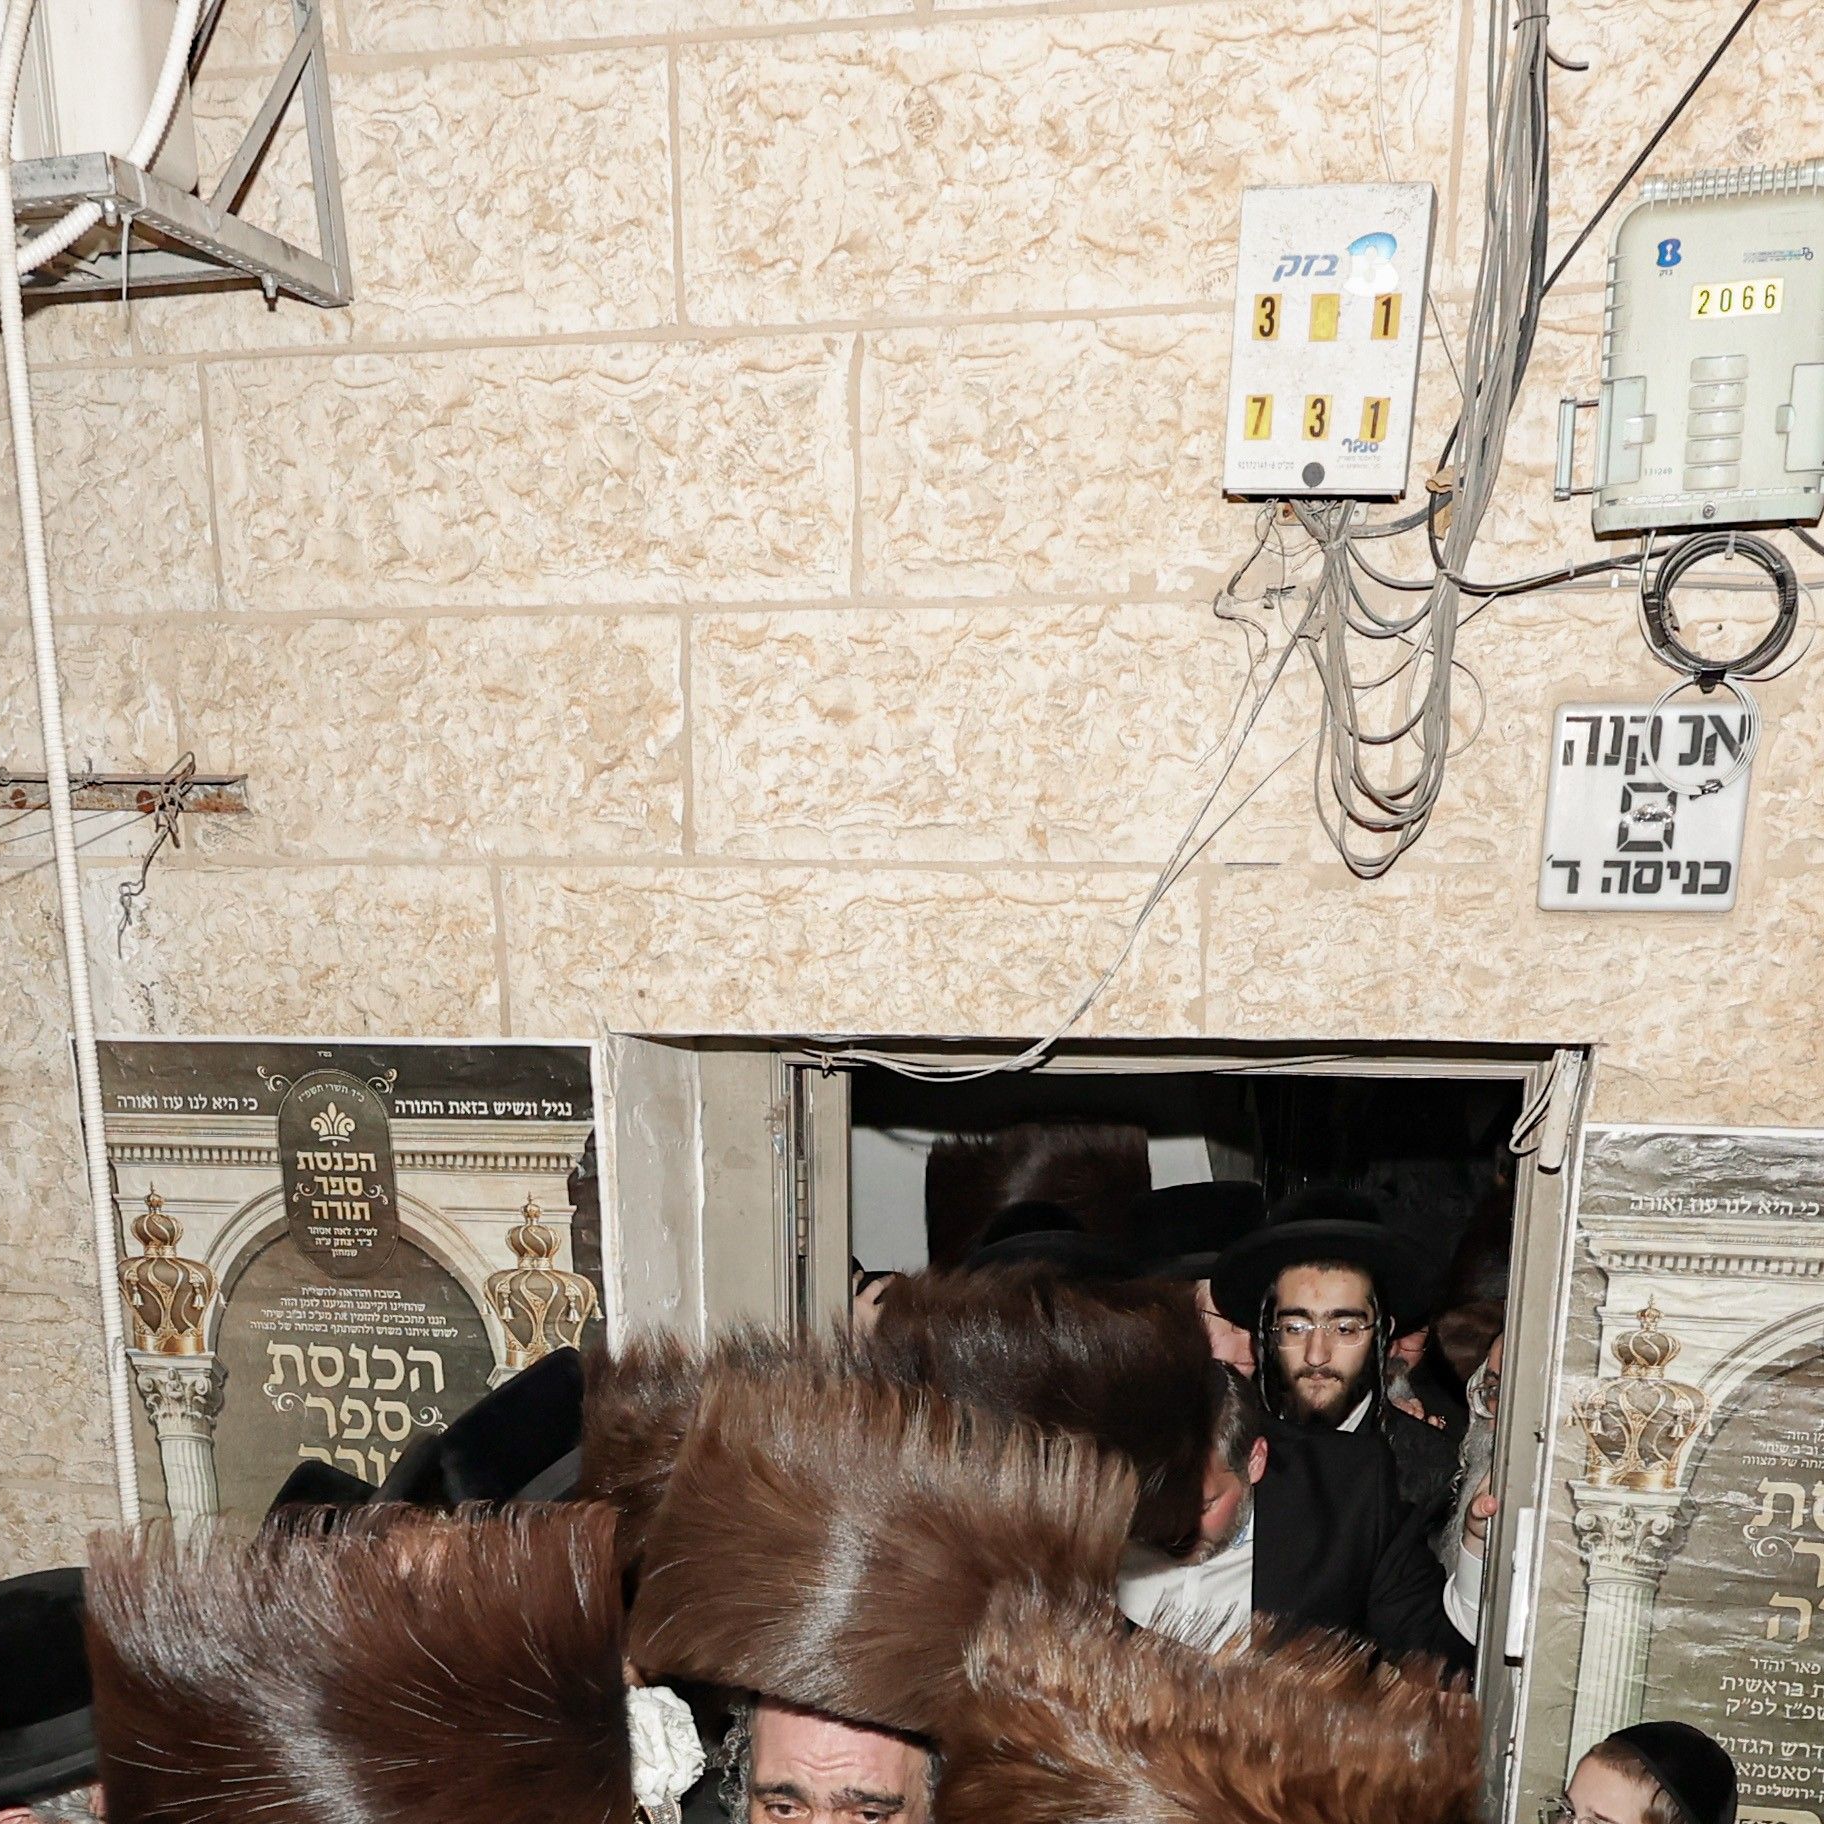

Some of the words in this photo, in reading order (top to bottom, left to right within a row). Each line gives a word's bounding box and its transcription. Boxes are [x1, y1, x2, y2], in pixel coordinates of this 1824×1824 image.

[1272, 254, 1340, 283] בזק
[1697, 284, 1776, 315] 2066
[1259, 296, 1276, 337] 3
[1381, 297, 1392, 336] 1
[1252, 397, 1267, 436] 7
[1309, 398, 1326, 438] 3
[1370, 400, 1381, 439] 1
[1616, 782, 1678, 852] 8
[1600, 860, 1732, 894] כניסה
[325, 1083, 349, 1094] תשרי
[117, 1094, 157, 1109] ואורה
[162, 1096, 183, 1110] עוז
[188, 1094, 207, 1110] לנו
[212, 1097, 238, 1111] היא
[242, 1097, 258, 1111] כי
[395, 1100, 444, 1115] התורה
[448, 1101, 488, 1115] בזאת
[541, 1100, 572, 1117] נגיל
[493, 1102, 537, 1116] ונשיש
[296, 1151, 377, 1172] הכנסת
[313, 1175, 363, 1196] ספר
[311, 1200, 371, 1221] תורה
[1630, 1196, 1683, 1213] ואורה
[1690, 1198, 1718, 1213] עוז
[1725, 1196, 1752, 1214] לנו
[1758, 1198, 1793, 1216] היא
[1800, 1201, 1820, 1216] כי
[307, 1226, 332, 1235] אסתר
[333, 1226, 351, 1235] לאה
[333, 1238, 355, 1247] יצחק
[331, 1248, 358, 1258] שמחון
[339, 1287, 371, 1298] והודאה
[373, 1289, 401, 1299] בשבח
[280, 1297, 298, 1306] הזה
[299, 1297, 320, 1308] לזמן
[322, 1299, 354, 1309] והגיענו
[356, 1301, 387, 1312] וקיימנו
[389, 1302, 426, 1311] שהחיינו
[334, 1311, 348, 1321] את
[350, 1312, 380, 1323] להזמין
[382, 1314, 425, 1324] מתכבדים
[427, 1316, 446, 1325] הננו
[249, 1320, 276, 1331] מצווה
[278, 1320, 292, 1331] של
[294, 1322, 328, 1332] בשמחה
[330, 1323, 374, 1334] ולהשתתף
[376, 1326, 402, 1336] משוש
[404, 1327, 430, 1337] איתנו
[431, 1327, 458, 1337] לשוש
[266, 1339, 445, 1393] הכנסת
[305, 1392, 412, 1442] ספר
[1787, 1430, 1810, 1441] הזה
[298, 1443, 402, 1488] ור
[1742, 1455, 1776, 1466] מצווה
[1780, 1456, 1797, 1467] של
[1749, 1657, 1785, 1673] והדר
[1791, 1660, 1821, 1675] פאר
[1719, 1675, 1804, 1698] בראשית
[1725, 1697, 1778, 1717] לפ"ק
[1716, 1733, 1774, 1755] הגדול
[1756, 1783, 1815, 1800] ירושלים
